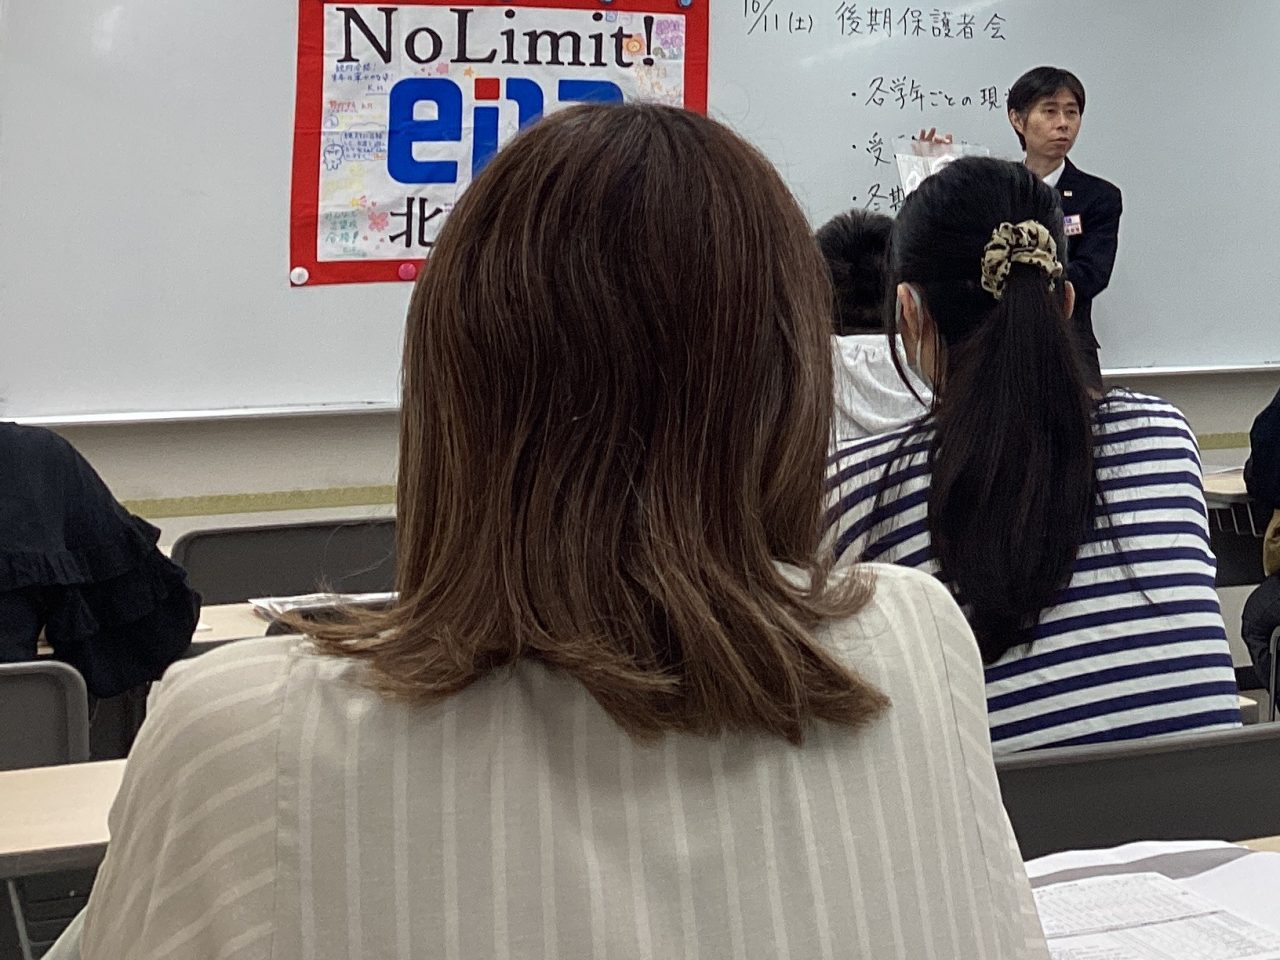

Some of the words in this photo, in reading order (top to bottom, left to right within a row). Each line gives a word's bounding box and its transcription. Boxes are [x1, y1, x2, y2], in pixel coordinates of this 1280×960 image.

[835, 0, 1007, 41] 後期保護者会
